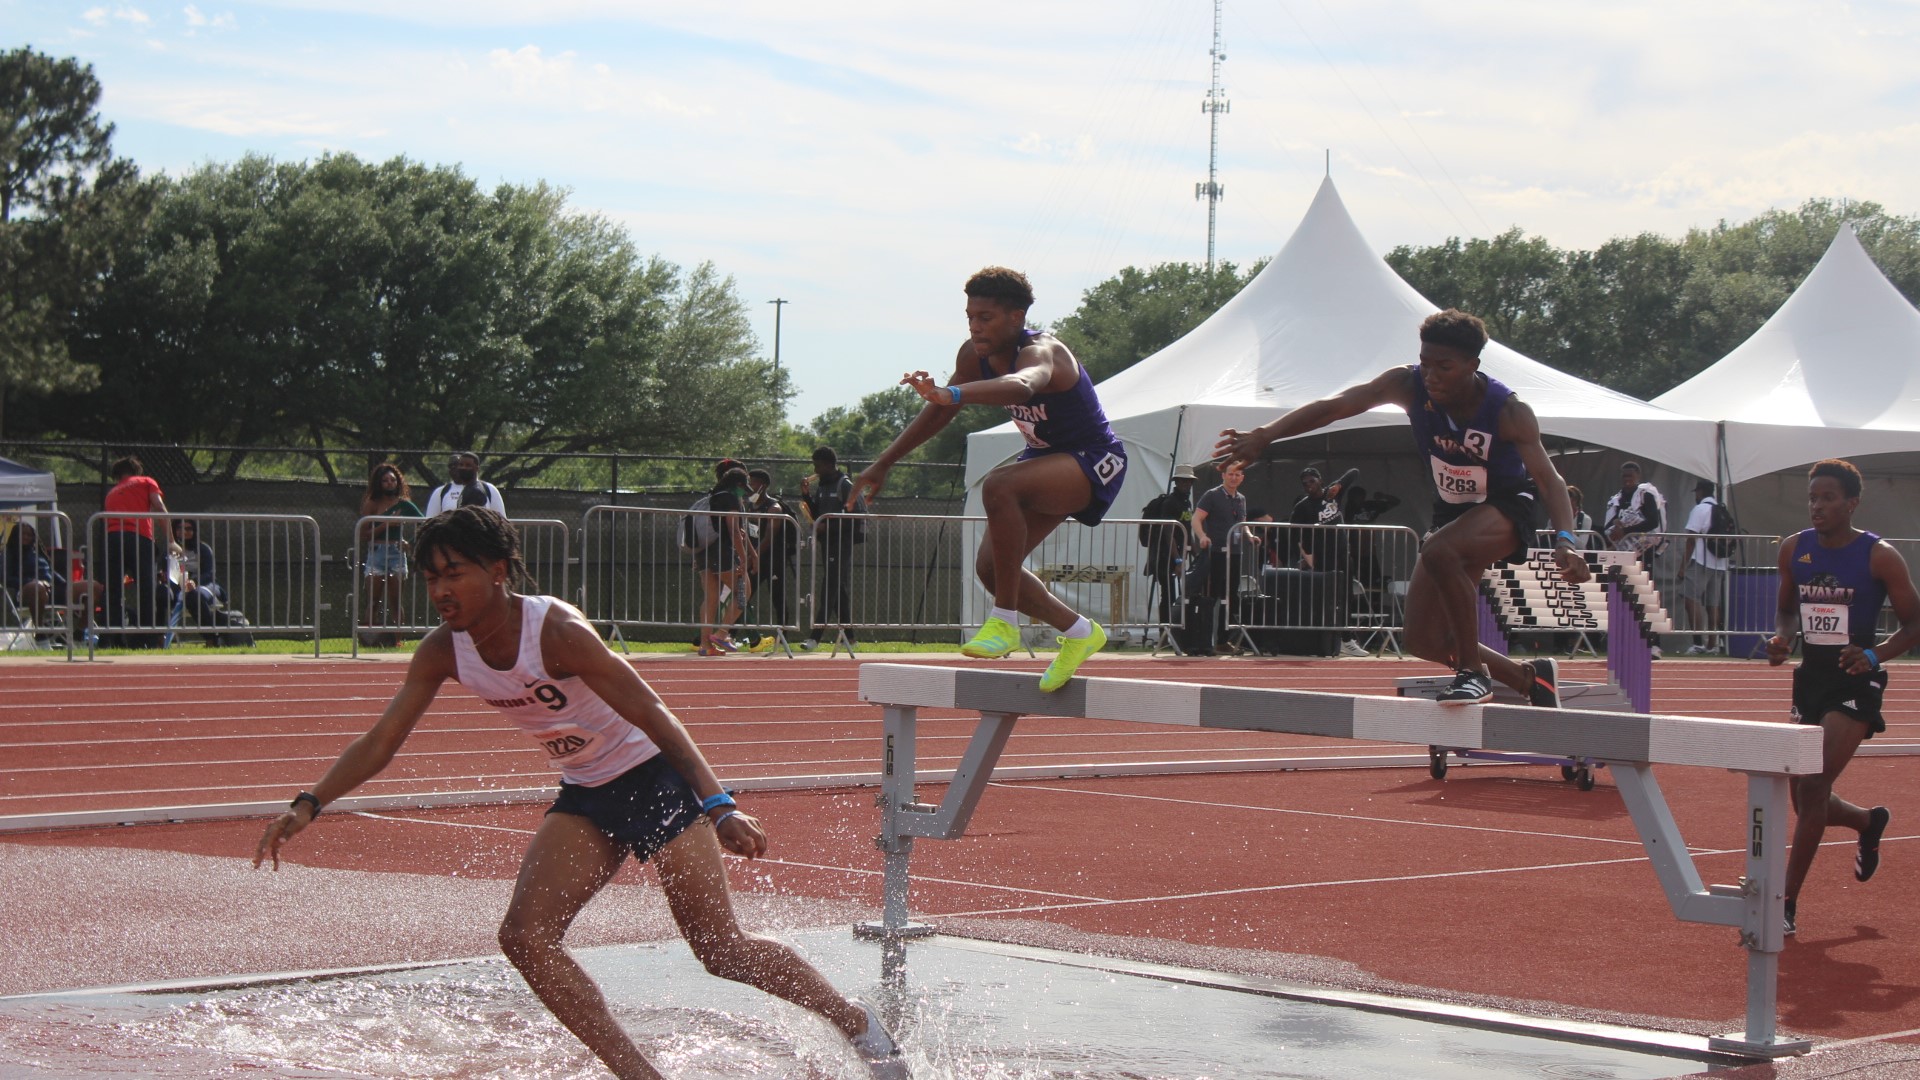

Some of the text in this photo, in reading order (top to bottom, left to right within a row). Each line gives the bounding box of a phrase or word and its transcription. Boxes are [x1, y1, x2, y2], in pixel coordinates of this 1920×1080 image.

[1004, 403, 1048, 422] ORN
[1468, 432, 1485, 457] 3
[1098, 455, 1120, 479] 5
[1438, 472, 1476, 492] 1263
[1541, 581, 1580, 590] UCS
[1545, 590, 1585, 600] UCS
[1798, 584, 1854, 602] PVAMU
[1547, 600, 1586, 609] UCS
[1553, 609, 1592, 618] UCS
[1558, 618, 1598, 628] UCS
[1808, 616, 1840, 631] 1267
[534, 684, 567, 711] 9
[540, 735, 586, 757] 1220
[886, 735, 894, 775] UCS
[1753, 808, 1763, 857] UCS
